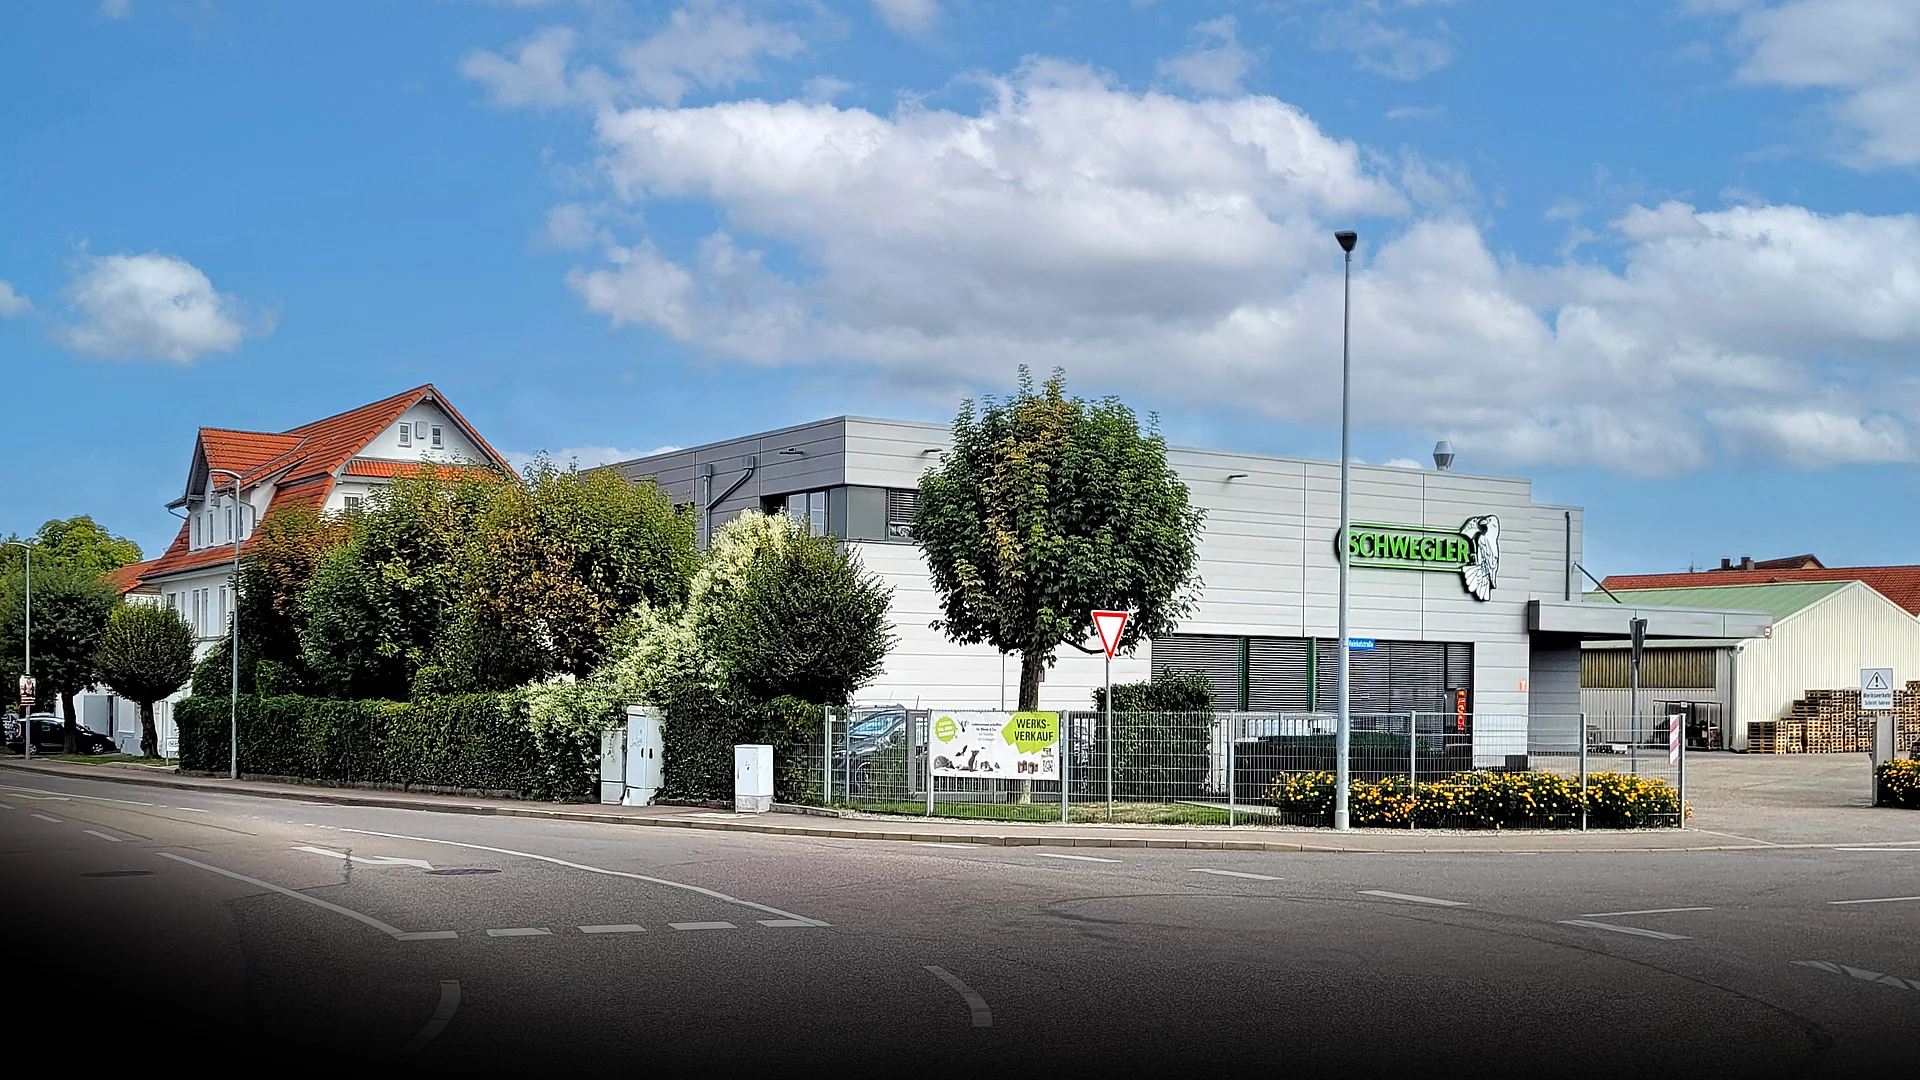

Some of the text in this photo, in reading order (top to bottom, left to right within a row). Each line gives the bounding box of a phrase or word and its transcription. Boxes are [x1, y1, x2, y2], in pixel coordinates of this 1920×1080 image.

[1349, 531, 1470, 563] SCHWEGLER
[1016, 718, 1051, 729] WERKS-
[1014, 731, 1054, 742] VERKAUF
